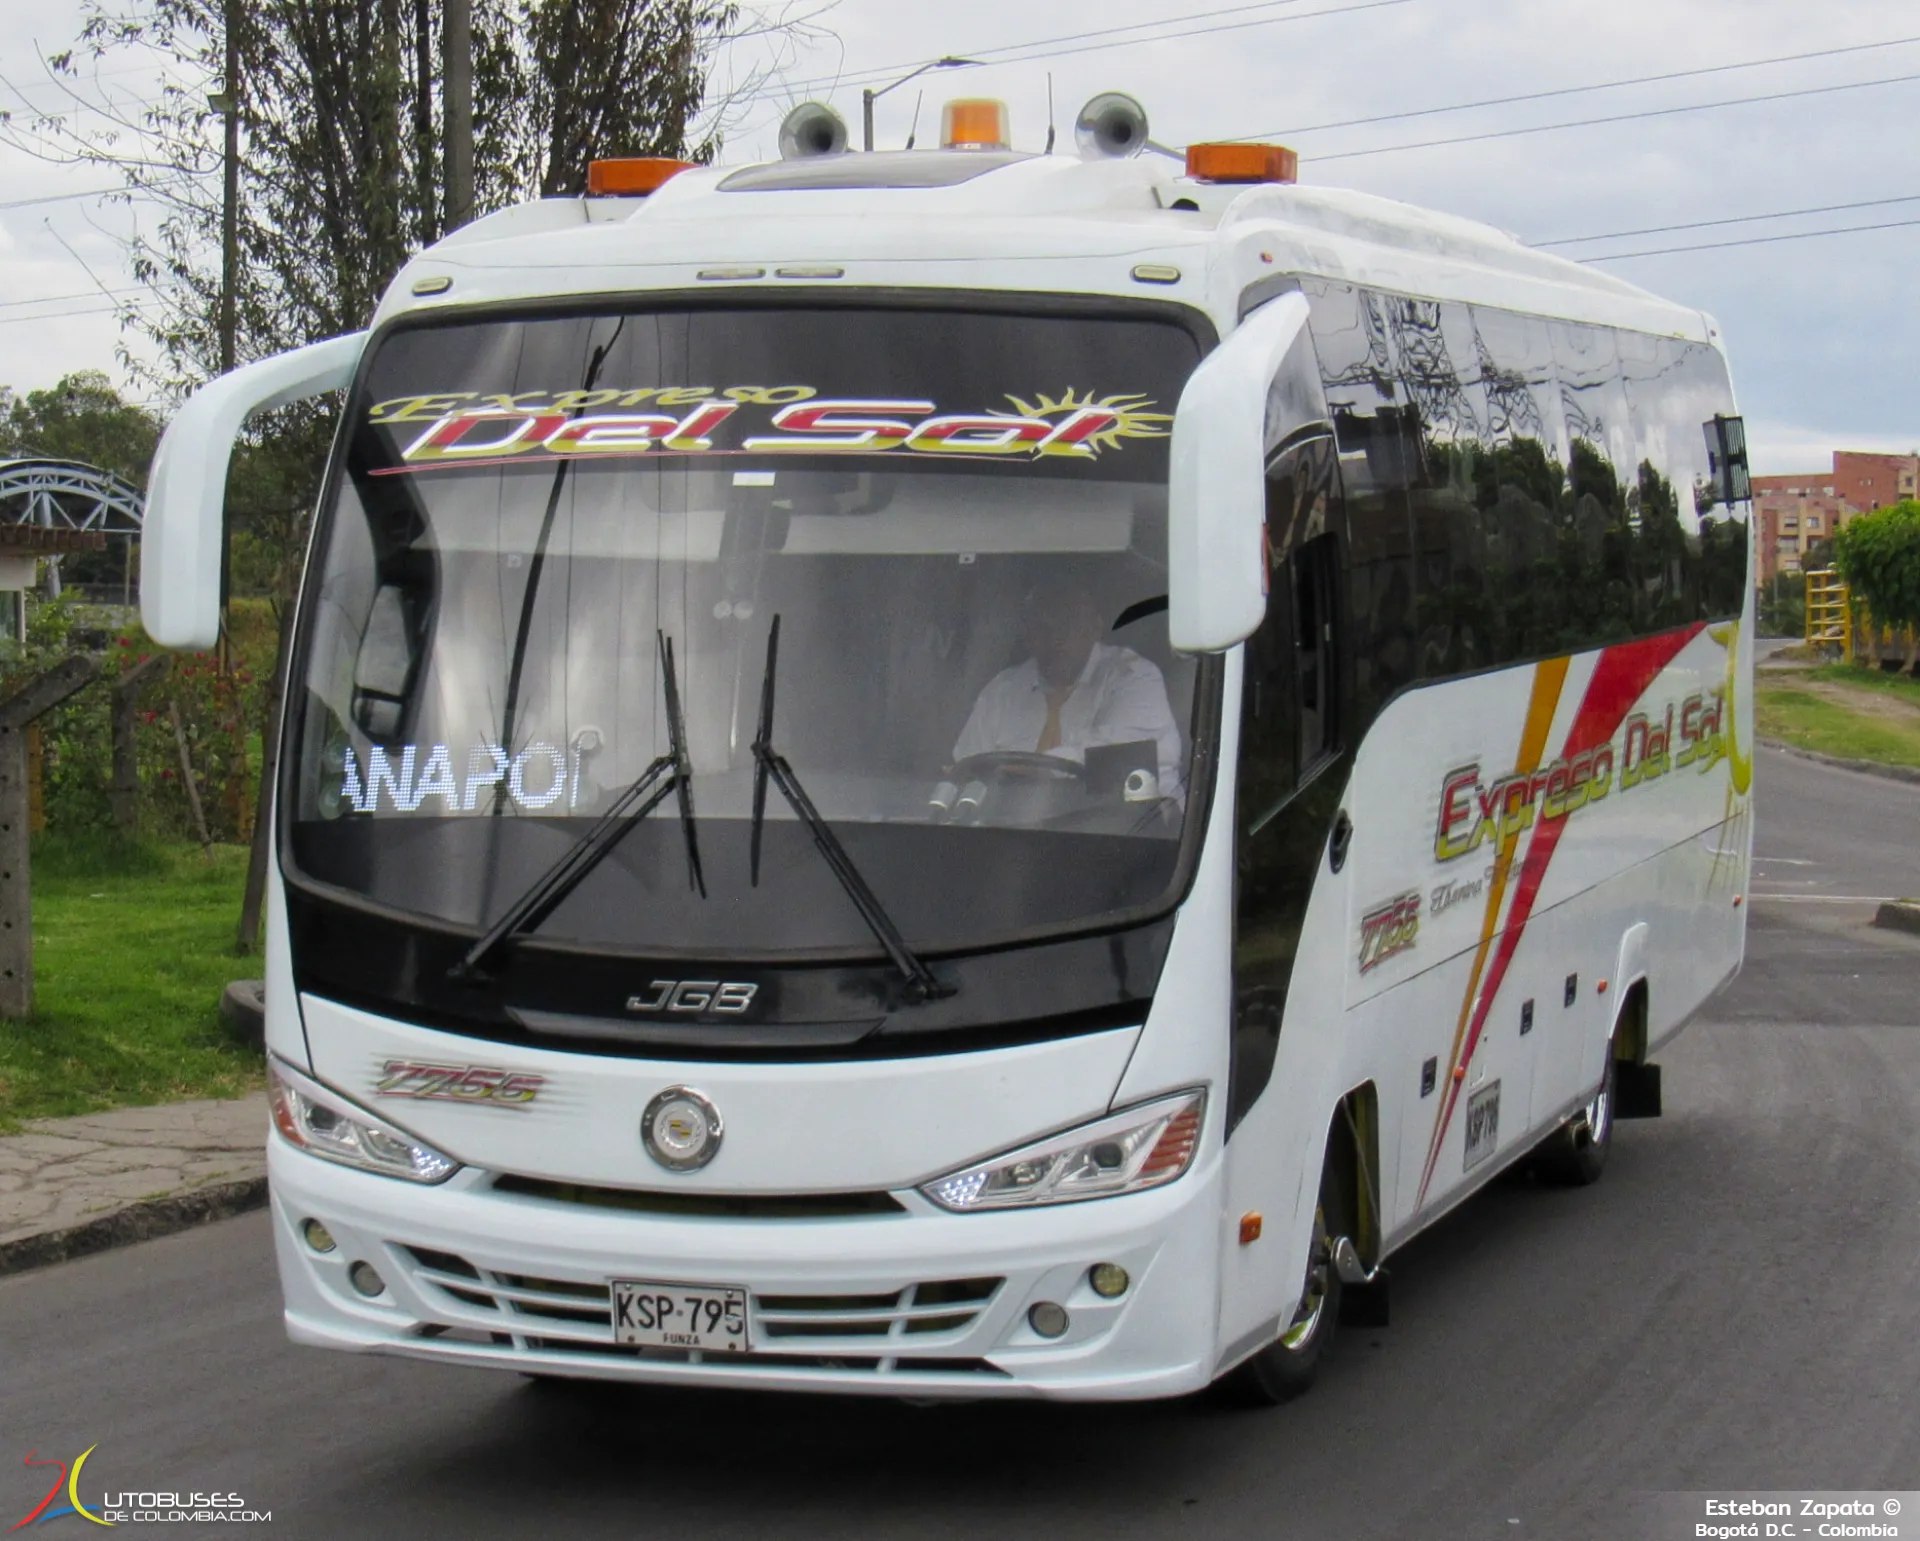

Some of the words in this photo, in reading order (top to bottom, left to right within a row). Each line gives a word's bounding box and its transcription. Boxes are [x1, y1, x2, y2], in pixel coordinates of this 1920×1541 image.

[369, 384, 817, 424] Expreso
[402, 398, 739, 460] Del
[742, 398, 1119, 456] Sol
[1434, 741, 1614, 862] Expreso
[1620, 702, 1673, 792] Del
[1676, 690, 1726, 772] Sol
[626, 980, 759, 1014] JGB
[663, 1333, 701, 1346] FUNZA
